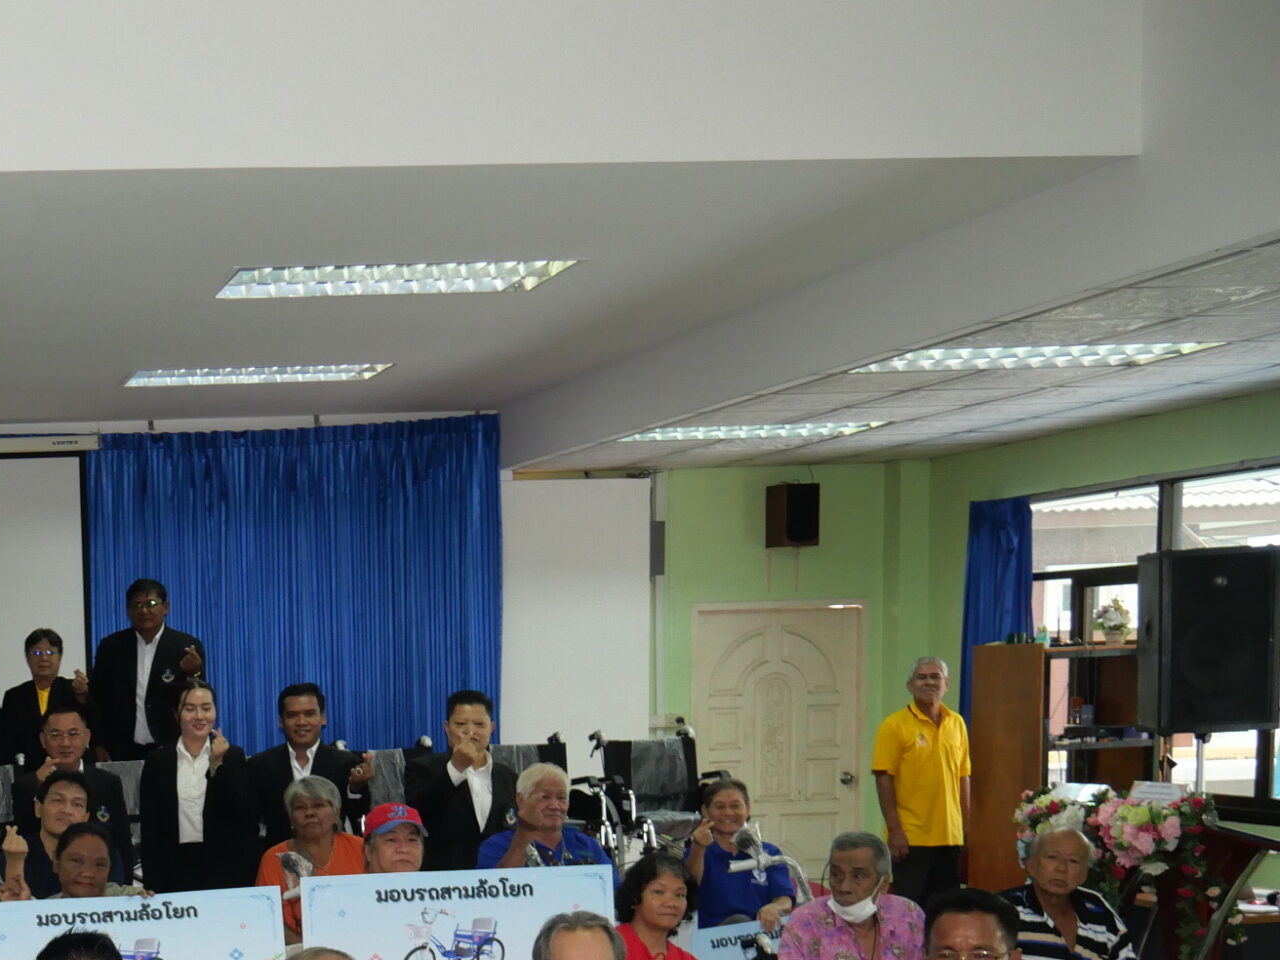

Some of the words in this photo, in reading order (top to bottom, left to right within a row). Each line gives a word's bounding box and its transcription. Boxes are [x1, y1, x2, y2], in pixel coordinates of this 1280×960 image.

[376, 877, 534, 904] มอบรถสามล้อโยก
[36, 901, 198, 928] มอบรถสามล้อโยก
